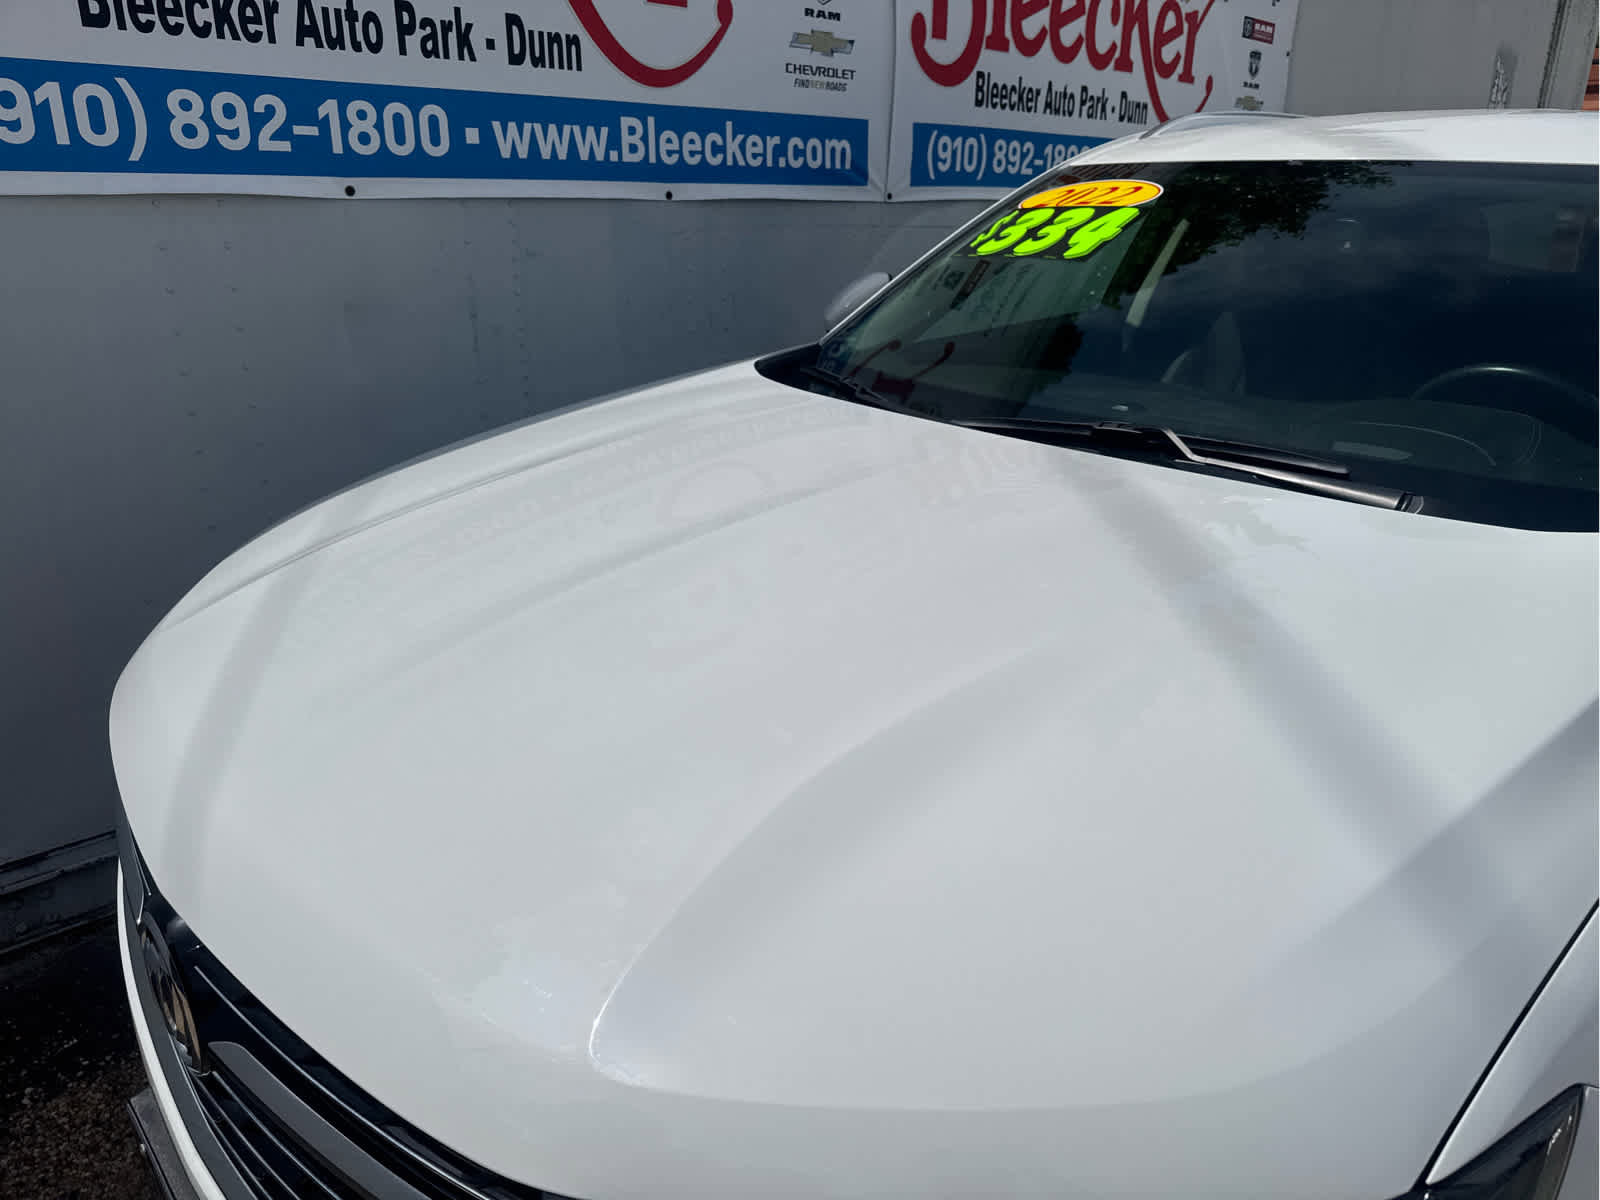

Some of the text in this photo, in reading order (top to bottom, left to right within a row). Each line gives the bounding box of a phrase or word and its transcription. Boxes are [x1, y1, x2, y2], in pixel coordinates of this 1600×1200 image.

[78, 0, 280, 45] Bleecker
[295, 0, 384, 55] Auto
[394, 0, 477, 62] Park
[504, 12, 583, 72] Dunn
[804, 7, 841, 22] RAM
[785, 62, 856, 81] CHEVROLET
[974, 70, 1148, 125] Bleecker Auto Park Dunn
[166, 88, 450, 157] 892-1800
[491, 116, 852, 171] www.Bleecker.com
[927, 130, 1094, 181] (910) 892-18
[1030, 186, 1143, 208] 2022
[969, 206, 1141, 260] $334
